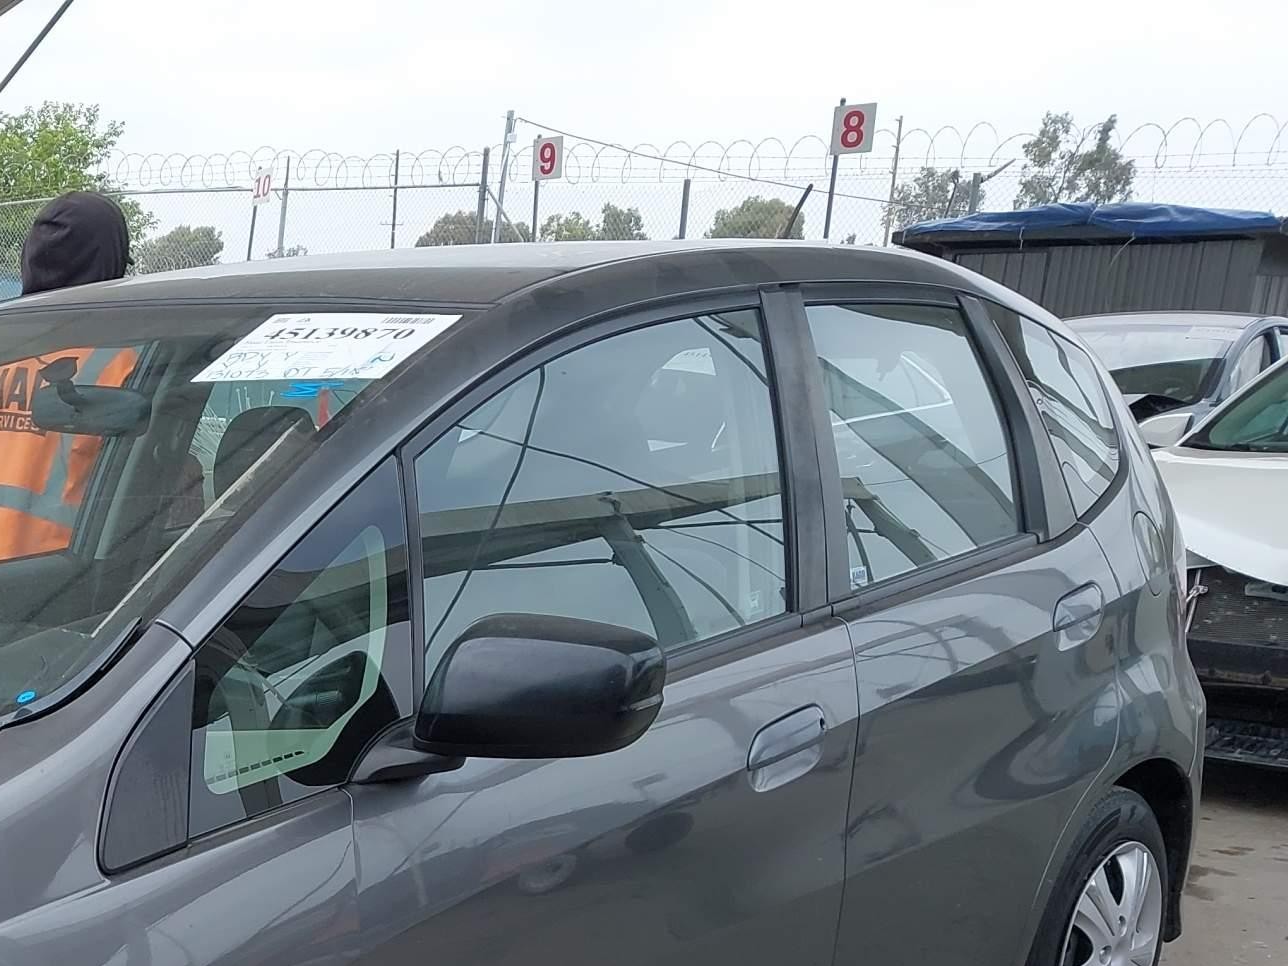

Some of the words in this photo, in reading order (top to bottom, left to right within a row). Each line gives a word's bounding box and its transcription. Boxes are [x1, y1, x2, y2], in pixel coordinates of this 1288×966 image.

[841, 110, 864, 148] 8
[539, 142, 557, 175] 9
[253, 173, 271, 199] 10
[264, 327, 416, 341] 45139870
